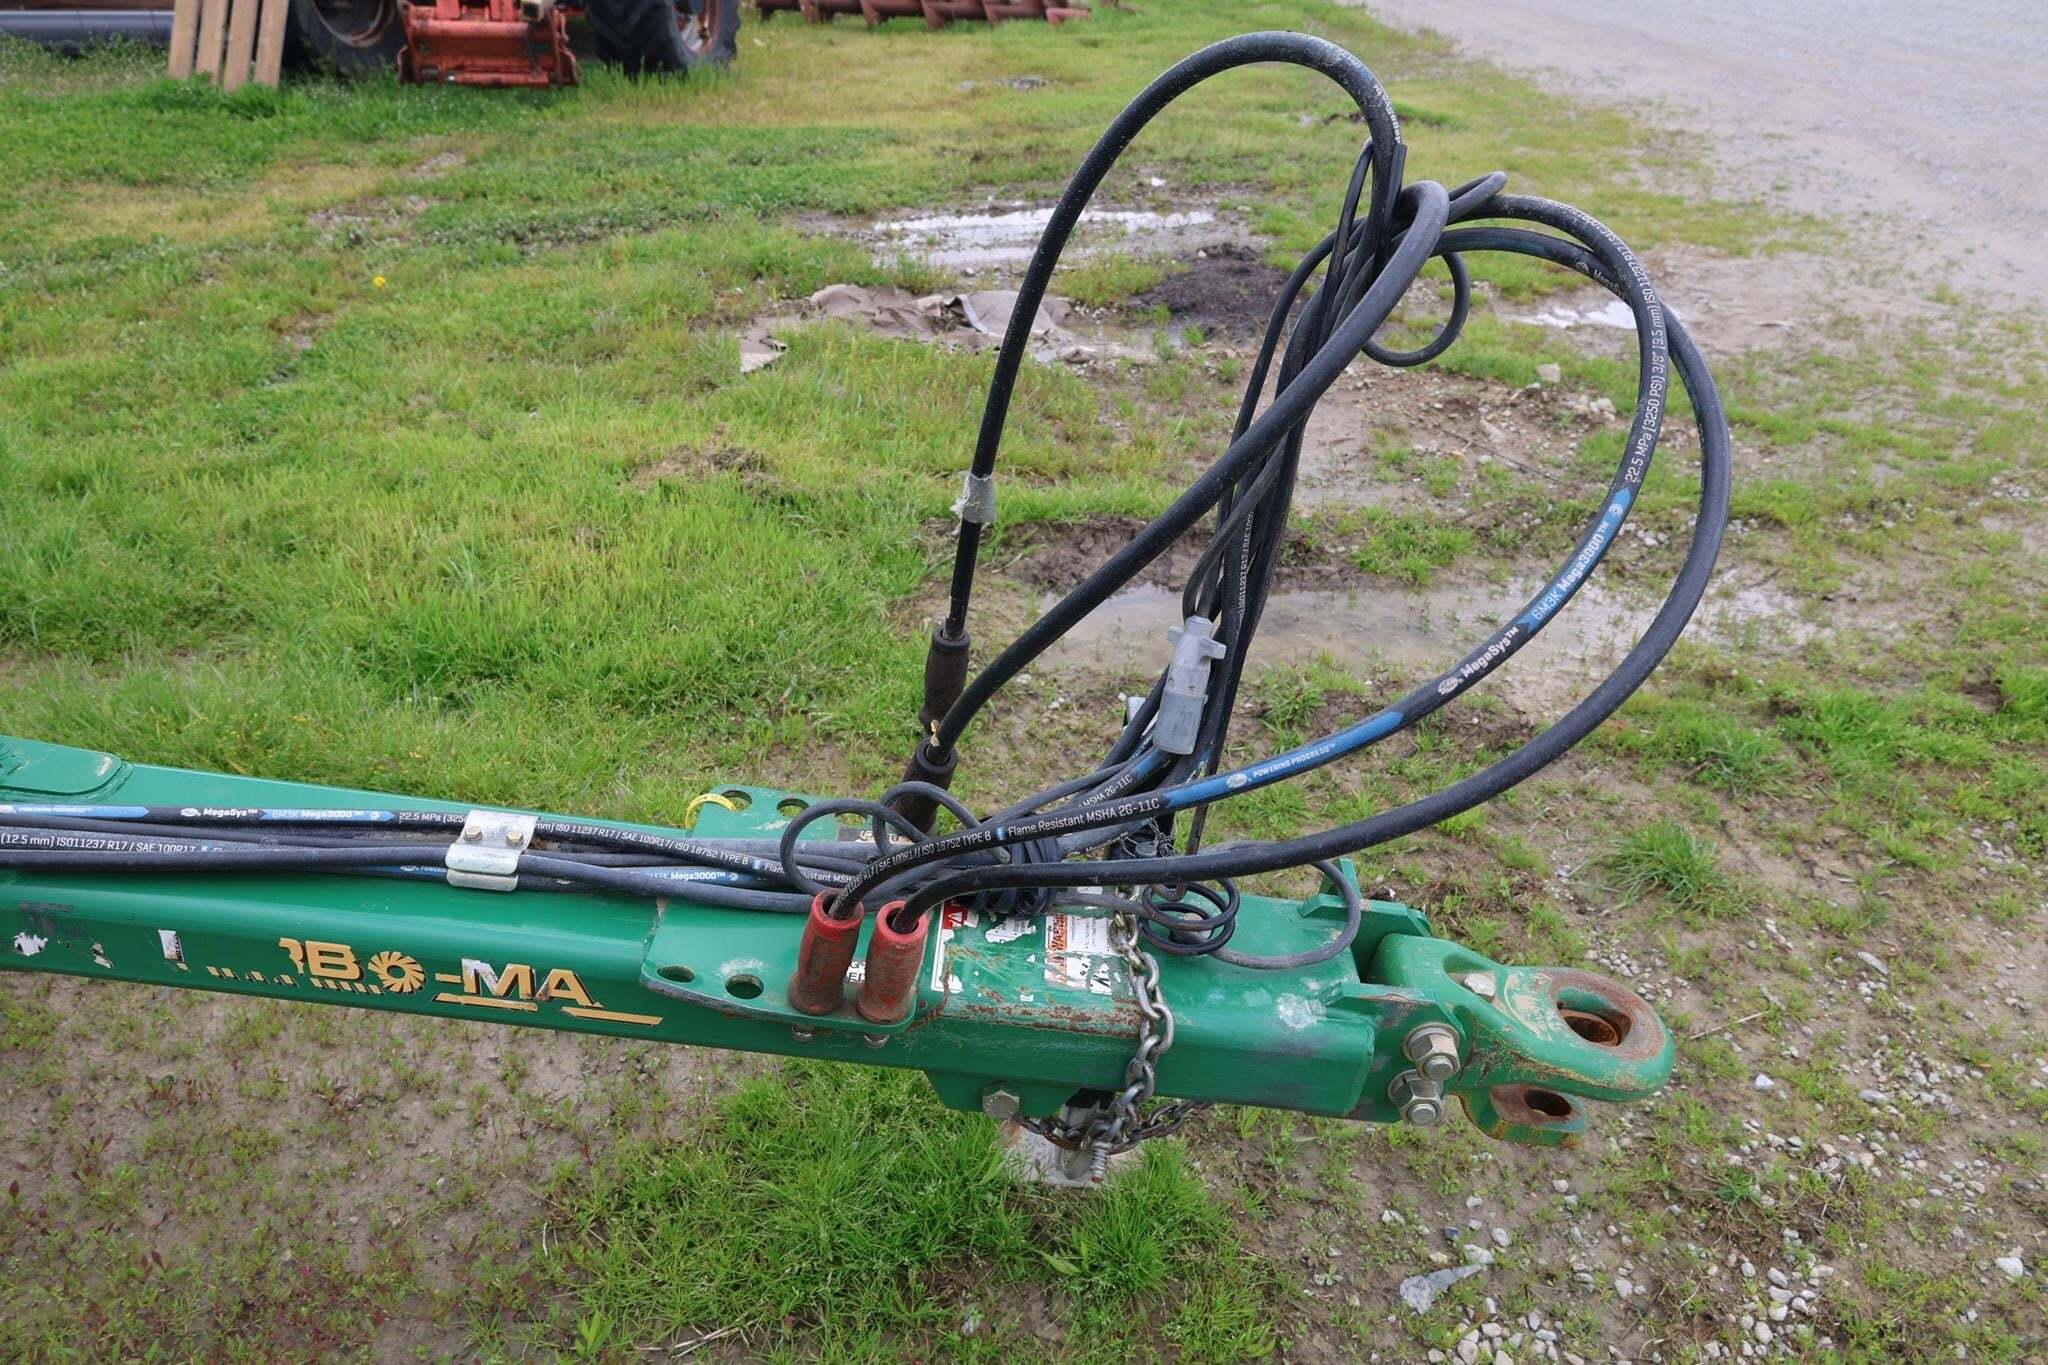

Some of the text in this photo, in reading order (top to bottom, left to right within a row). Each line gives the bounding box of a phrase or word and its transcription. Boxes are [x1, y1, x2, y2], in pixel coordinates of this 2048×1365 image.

[1647, 305, 1663, 328] mm)
[1649, 375, 1665, 398] PSI)
[1642, 399, 1660, 432] (3250
[1634, 433, 1652, 457] MPa
[1082, 774, 1133, 807] MSHA 2G-11C
[399, 812, 420, 821] 22.5
[422, 813, 441, 822] MPa
[962, 831, 984, 846] TYPE
[984, 830, 991, 841] B
[1007, 824, 1036, 838] Flame
[1038, 814, 1085, 832] Resistant
[1086, 808, 1116, 822] MSHA
[1118, 797, 1160, 816] 2G-11C
[30, 836, 55, 848] mm)
[57, 837, 106, 849] ISO11237
[107, 840, 128, 851] R17
[136, 842, 155, 852] SAE
[556, 824, 569, 832] ISO
[572, 825, 596, 835] 11237
[599, 828, 615, 838] R17
[621, 832, 638, 841] SAE
[674, 842, 690, 852] ISO
[691, 845, 718, 858] 18752
[720, 852, 740, 864] TYPE
[741, 857, 749, 865] B
[833, 874, 853, 883] MSH
